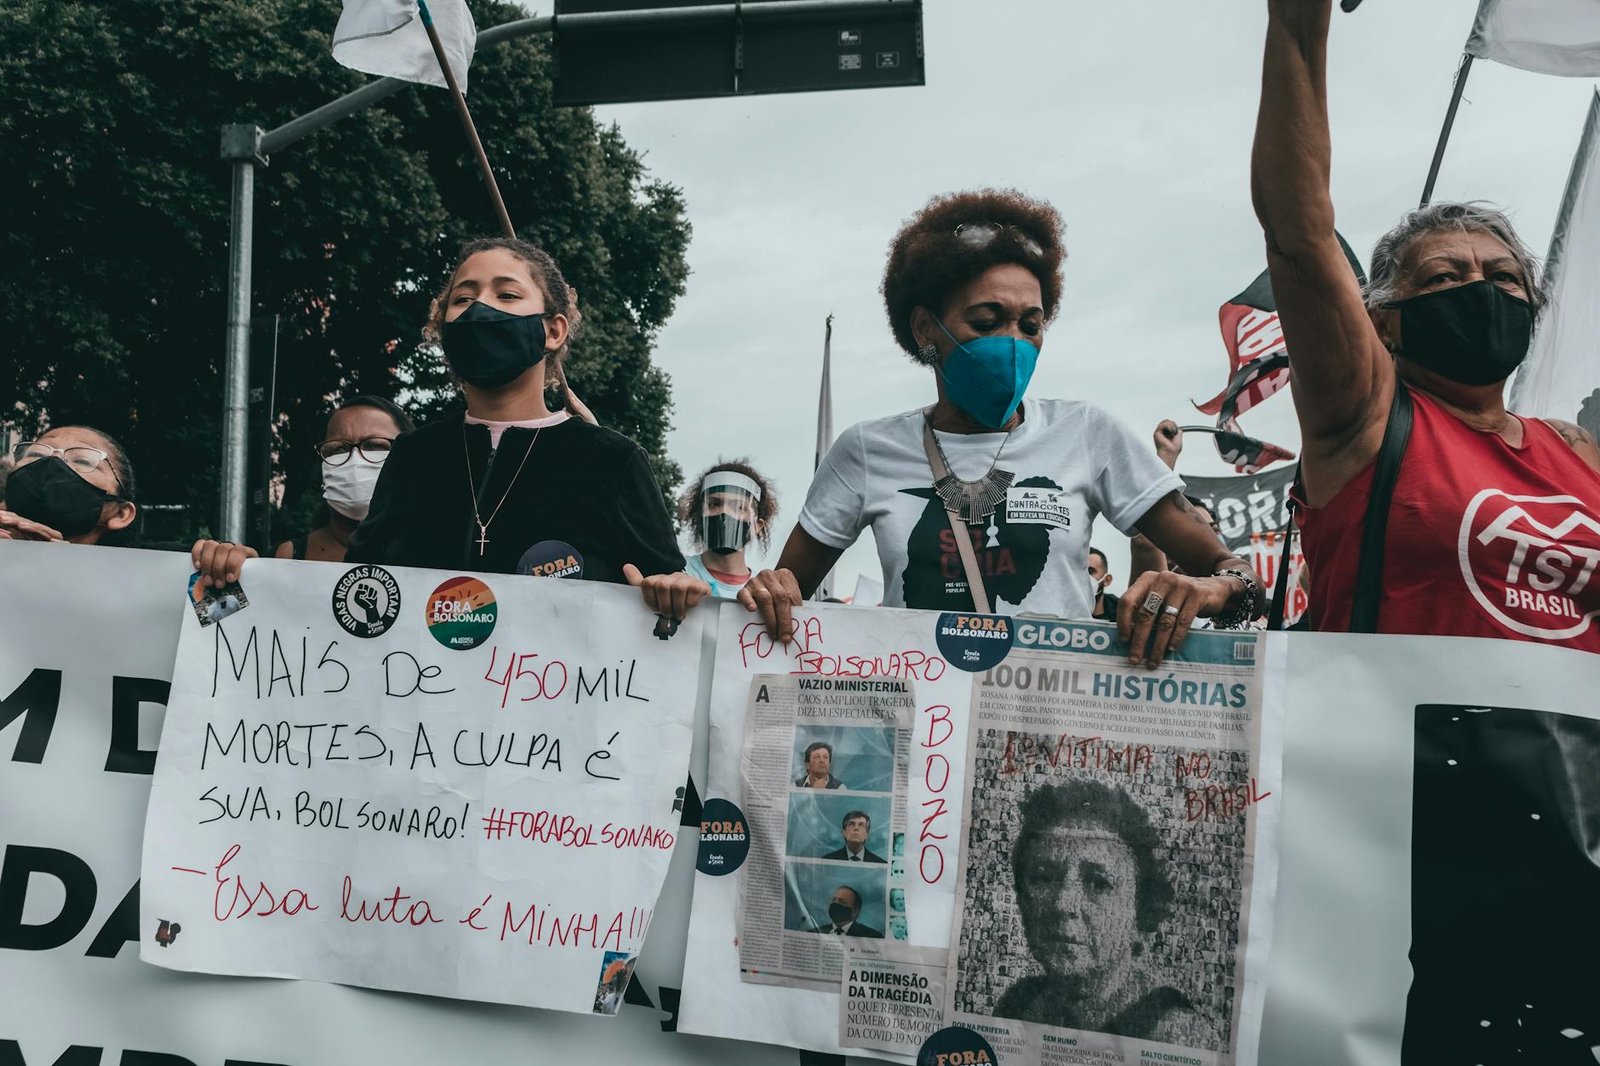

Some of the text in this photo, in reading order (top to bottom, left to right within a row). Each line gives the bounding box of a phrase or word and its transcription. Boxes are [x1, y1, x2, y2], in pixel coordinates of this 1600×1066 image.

[1009, 500, 1039, 509] CONTRA
[1040, 503, 1070, 516] CORTES
[532, 555, 578, 576] FORA
[336, 567, 369, 599] NEGRAS
[371, 567, 399, 618] IMPORTAM
[434, 600, 472, 613] FORA
[1505, 587, 1581, 619] BRASIL
[336, 601, 357, 631] VIDAS
[433, 612, 495, 623] BOLSONARO
[956, 616, 1009, 632] FORA
[738, 616, 823, 668] FORA
[941, 627, 1009, 640] BOLSONARO
[1017, 624, 1111, 651] GLOBO
[788, 650, 946, 681] BOLSONARO
[485, 646, 567, 708] 450
[798, 679, 908, 693] VAZIO MINISTERIAL
[981, 664, 1247, 708] 100 MIL HISTÓRIAS
[756, 684, 770, 703] A
[797, 694, 822, 705] CAOS
[824, 695, 868, 706] AMPLIOU
[797, 707, 896, 720] DIZEM ESPECIALISTAS
[980, 701, 991, 709] EM
[991, 702, 1014, 711] CINCO
[1039, 706, 1076, 717] PANDEMIA
[1078, 710, 1109, 720] MARCOU
[1109, 712, 1128, 722] PARA
[1129, 714, 1159, 725] SEMPRE
[1159, 718, 1197, 728] MILHARES
[1198, 719, 1208, 728] DE
[981, 691, 1008, 700] ROSANA
[1009, 692, 1047, 704] APARECIDA
[1048, 695, 1059, 704] FOI
[1067, 698, 1102, 709] PRIMEIRA
[1103, 702, 1118, 710] DAS
[1118, 703, 1130, 711] 100
[1131, 704, 1144, 713] MIL
[1146, 705, 1177, 717] VÍTIMAS
[1178, 708, 1187, 717] DE
[1188, 709, 1212, 719] COVID
[1213, 711, 1224, 720] NO
[979, 711, 1216, 740] EXPÔS O DESPREPARO DO GOVERNO E ACELEROU O PASSO DA CIÊNCIA
[201, 719, 394, 770] MORTES,
[410, 721, 437, 770] A
[453, 729, 562, 772] CULPA
[1176, 752, 1211, 779] NO
[920, 705, 953, 884] BOZO
[1187, 778, 1271, 822] BRASIL
[199, 786, 281, 825] SUA,
[295, 790, 470, 840] BOLSONARO!
[700, 821, 745, 833] FORA
[700, 833, 746, 841] LSONARO
[340, 874, 445, 926] luta
[849, 970, 928, 989] A DIMENSÃO
[848, 986, 932, 1005] DA TRAGÉDIA
[847, 1000, 855, 1011] O
[857, 1001, 879, 1013] QUE
[847, 1012, 891, 1028] NÚMERO
[892, 1018, 905, 1030] DE
[976, 1024, 1010, 1035] PERIFERIA
[847, 1027, 922, 1046] DA COVID-19 NO
[1042, 1034, 1077, 1046] SEM RUMO
[936, 1049, 991, 1066] FORA
[1141, 1050, 1162, 1060] SALTO
[1163, 1053, 1202, 1066] CIENTÍFICO
